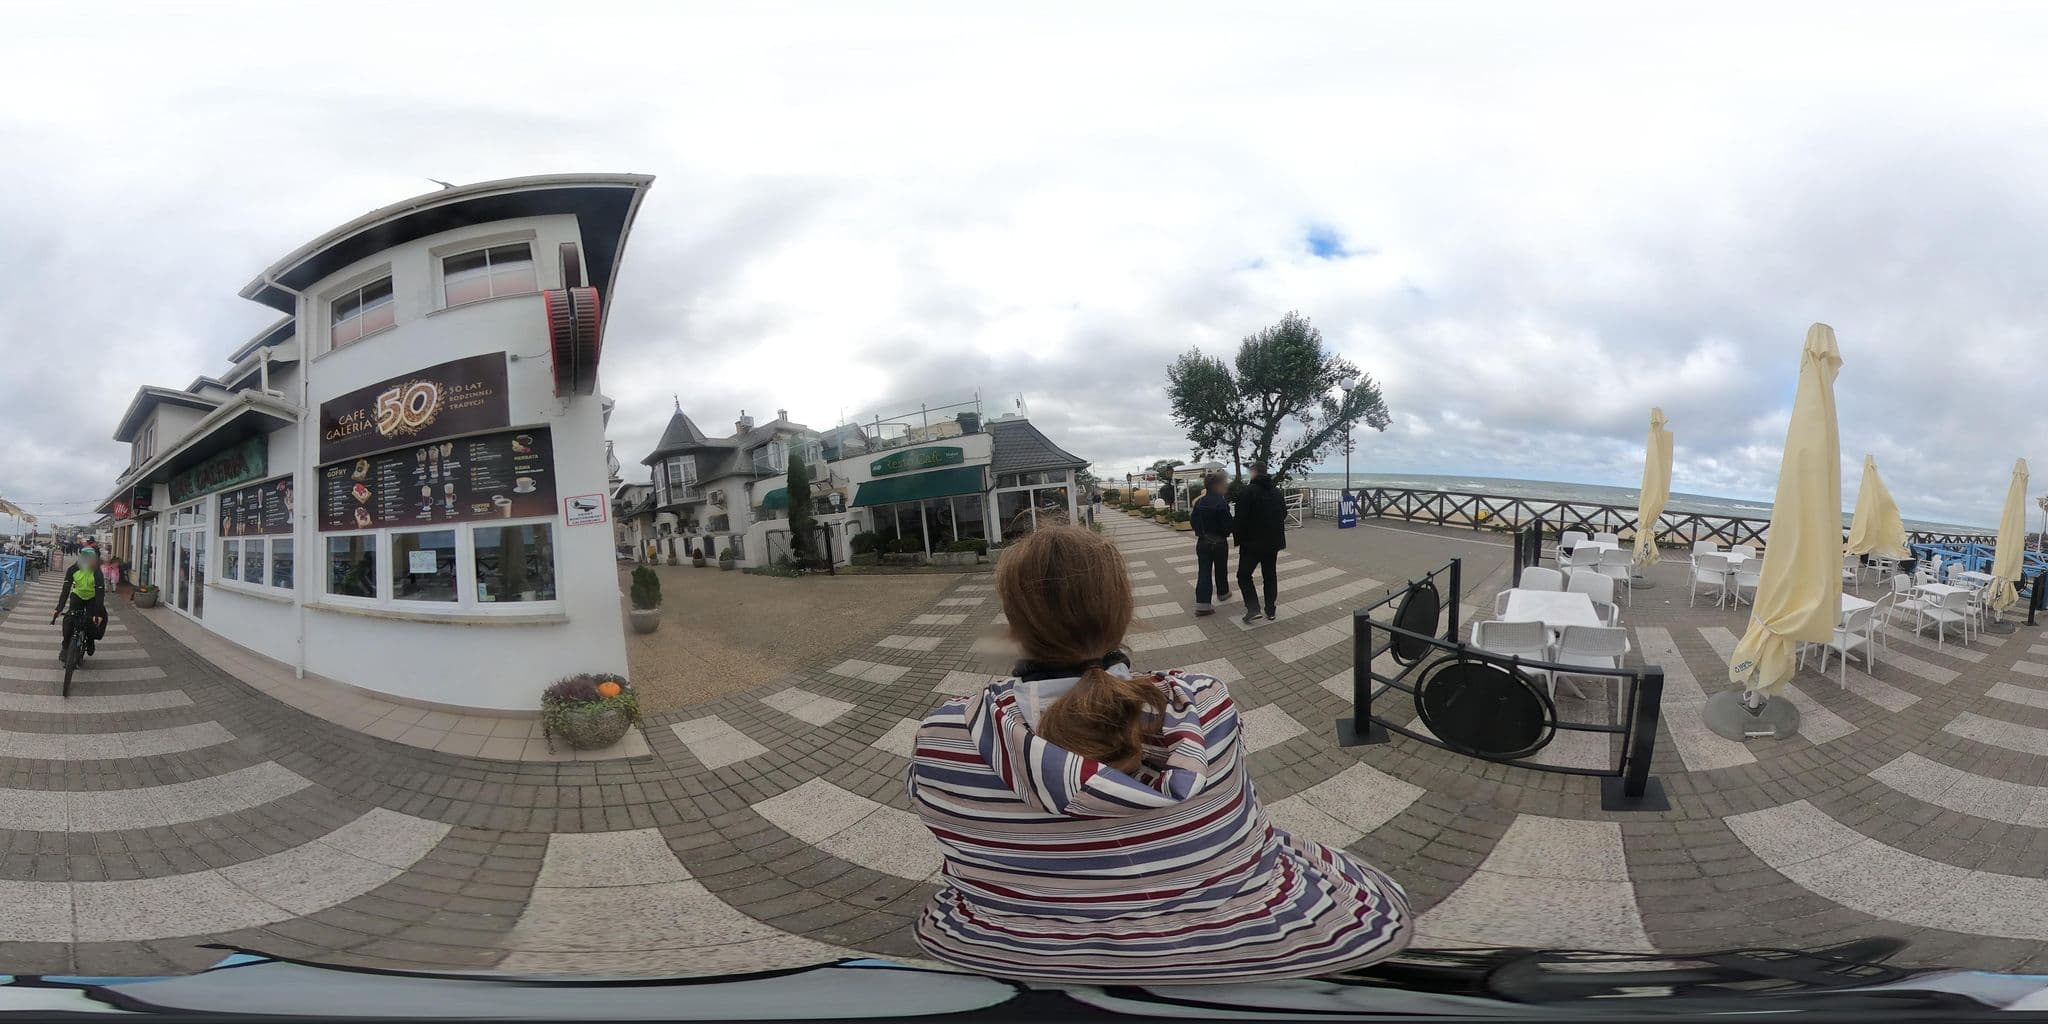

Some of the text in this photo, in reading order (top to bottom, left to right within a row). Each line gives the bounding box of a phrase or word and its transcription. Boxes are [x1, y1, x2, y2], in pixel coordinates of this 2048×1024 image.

[465, 382, 483, 391] LAT
[338, 408, 366, 426] CAFE
[376, 382, 438, 435] 50
[326, 419, 373, 441] GALERIA
[326, 468, 347, 478] GOFRY
[1340, 500, 1354, 516] WC
